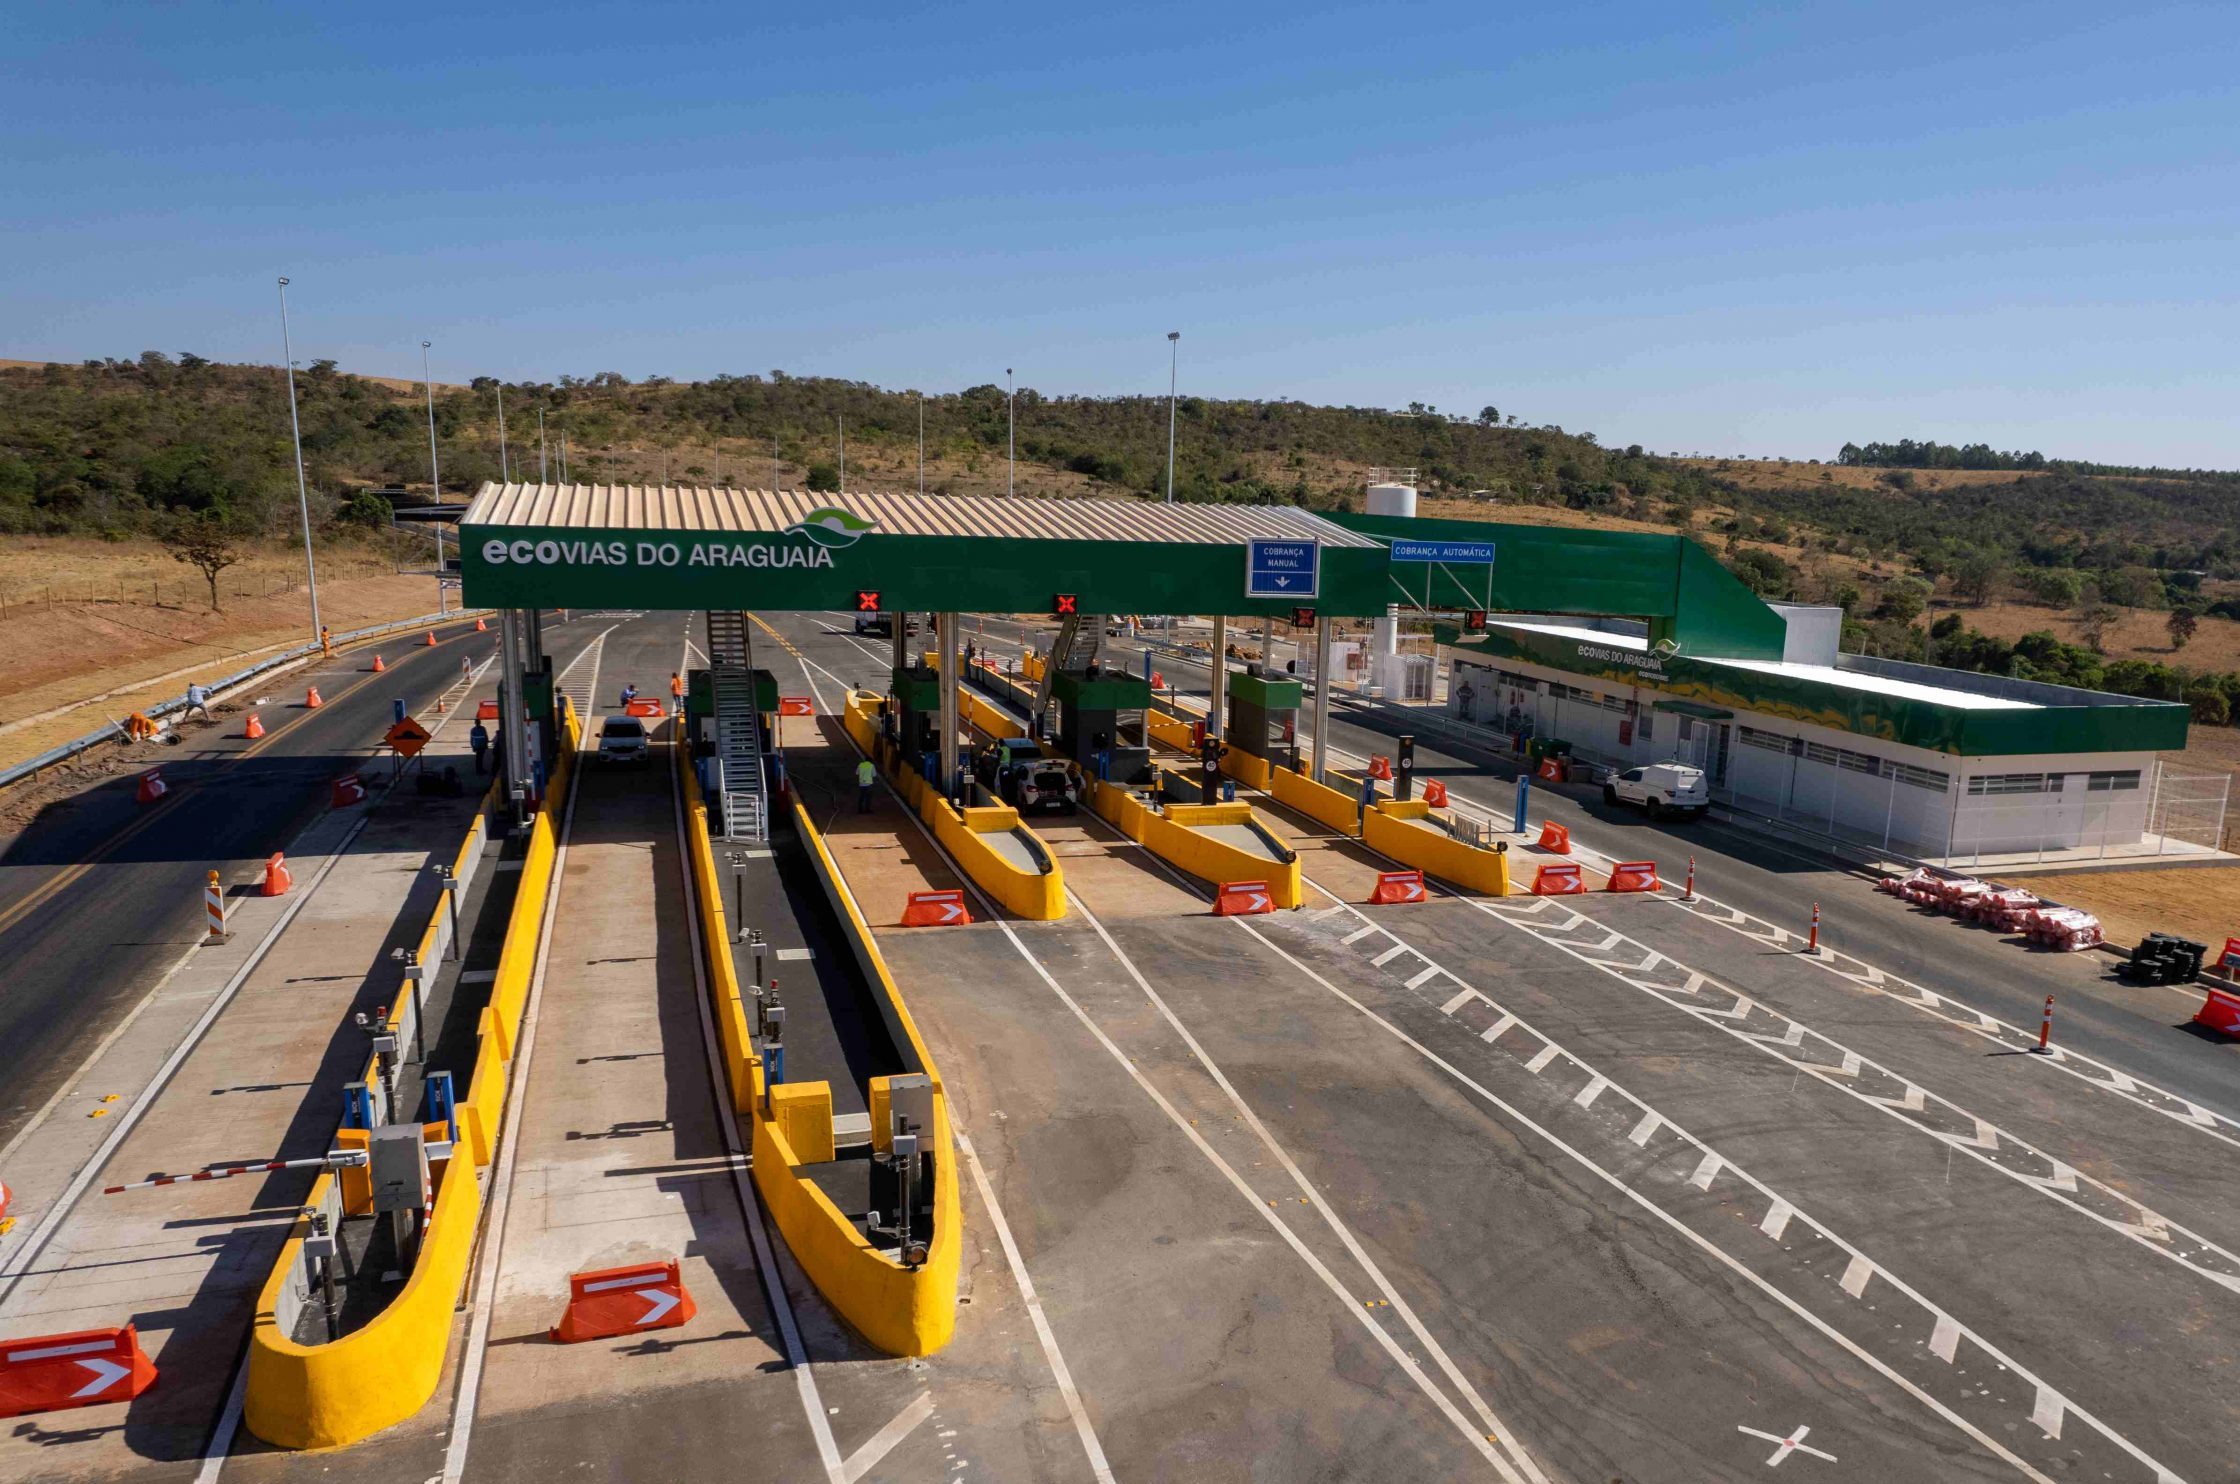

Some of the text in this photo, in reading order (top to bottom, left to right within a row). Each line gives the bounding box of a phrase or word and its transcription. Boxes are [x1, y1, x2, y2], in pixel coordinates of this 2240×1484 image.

[636, 542, 680, 567] DO
[688, 544, 834, 569] ARAGUAIA
[1263, 547, 1304, 558] COBRANÇA
[1396, 546, 1491, 558] COBRANÇA AUTOMÁTICA
[1268, 559, 1299, 568] MANUAL
[1611, 651, 1623, 663] DO
[1623, 654, 1662, 671] ARAGUAIA
